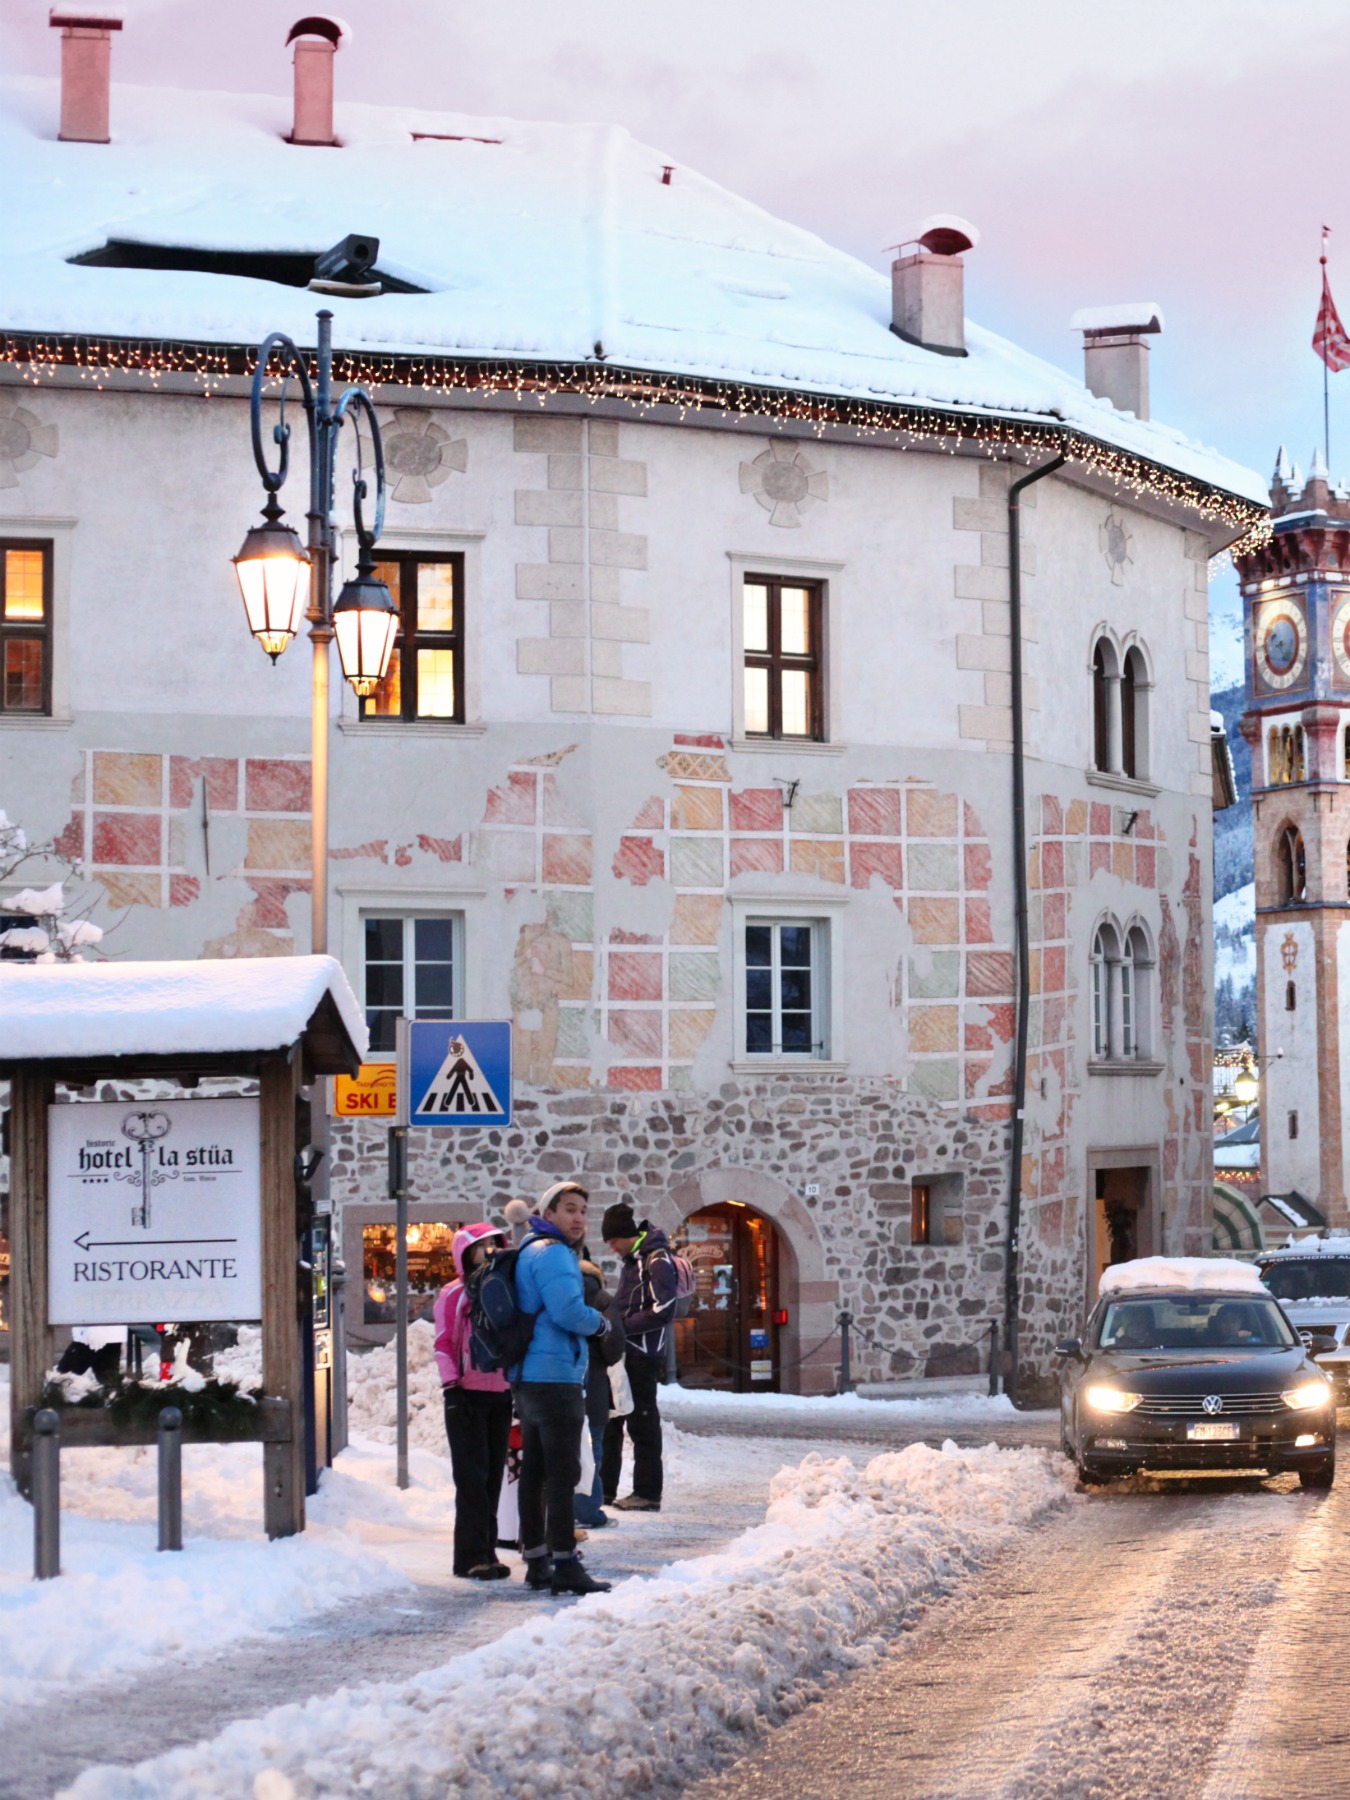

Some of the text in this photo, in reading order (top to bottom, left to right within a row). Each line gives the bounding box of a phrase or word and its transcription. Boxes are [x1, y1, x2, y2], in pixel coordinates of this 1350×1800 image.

[346, 1093, 378, 1109] SKI
[78, 1144, 234, 1173] hotel la stüa
[73, 1258, 238, 1282] RISTORANTE
